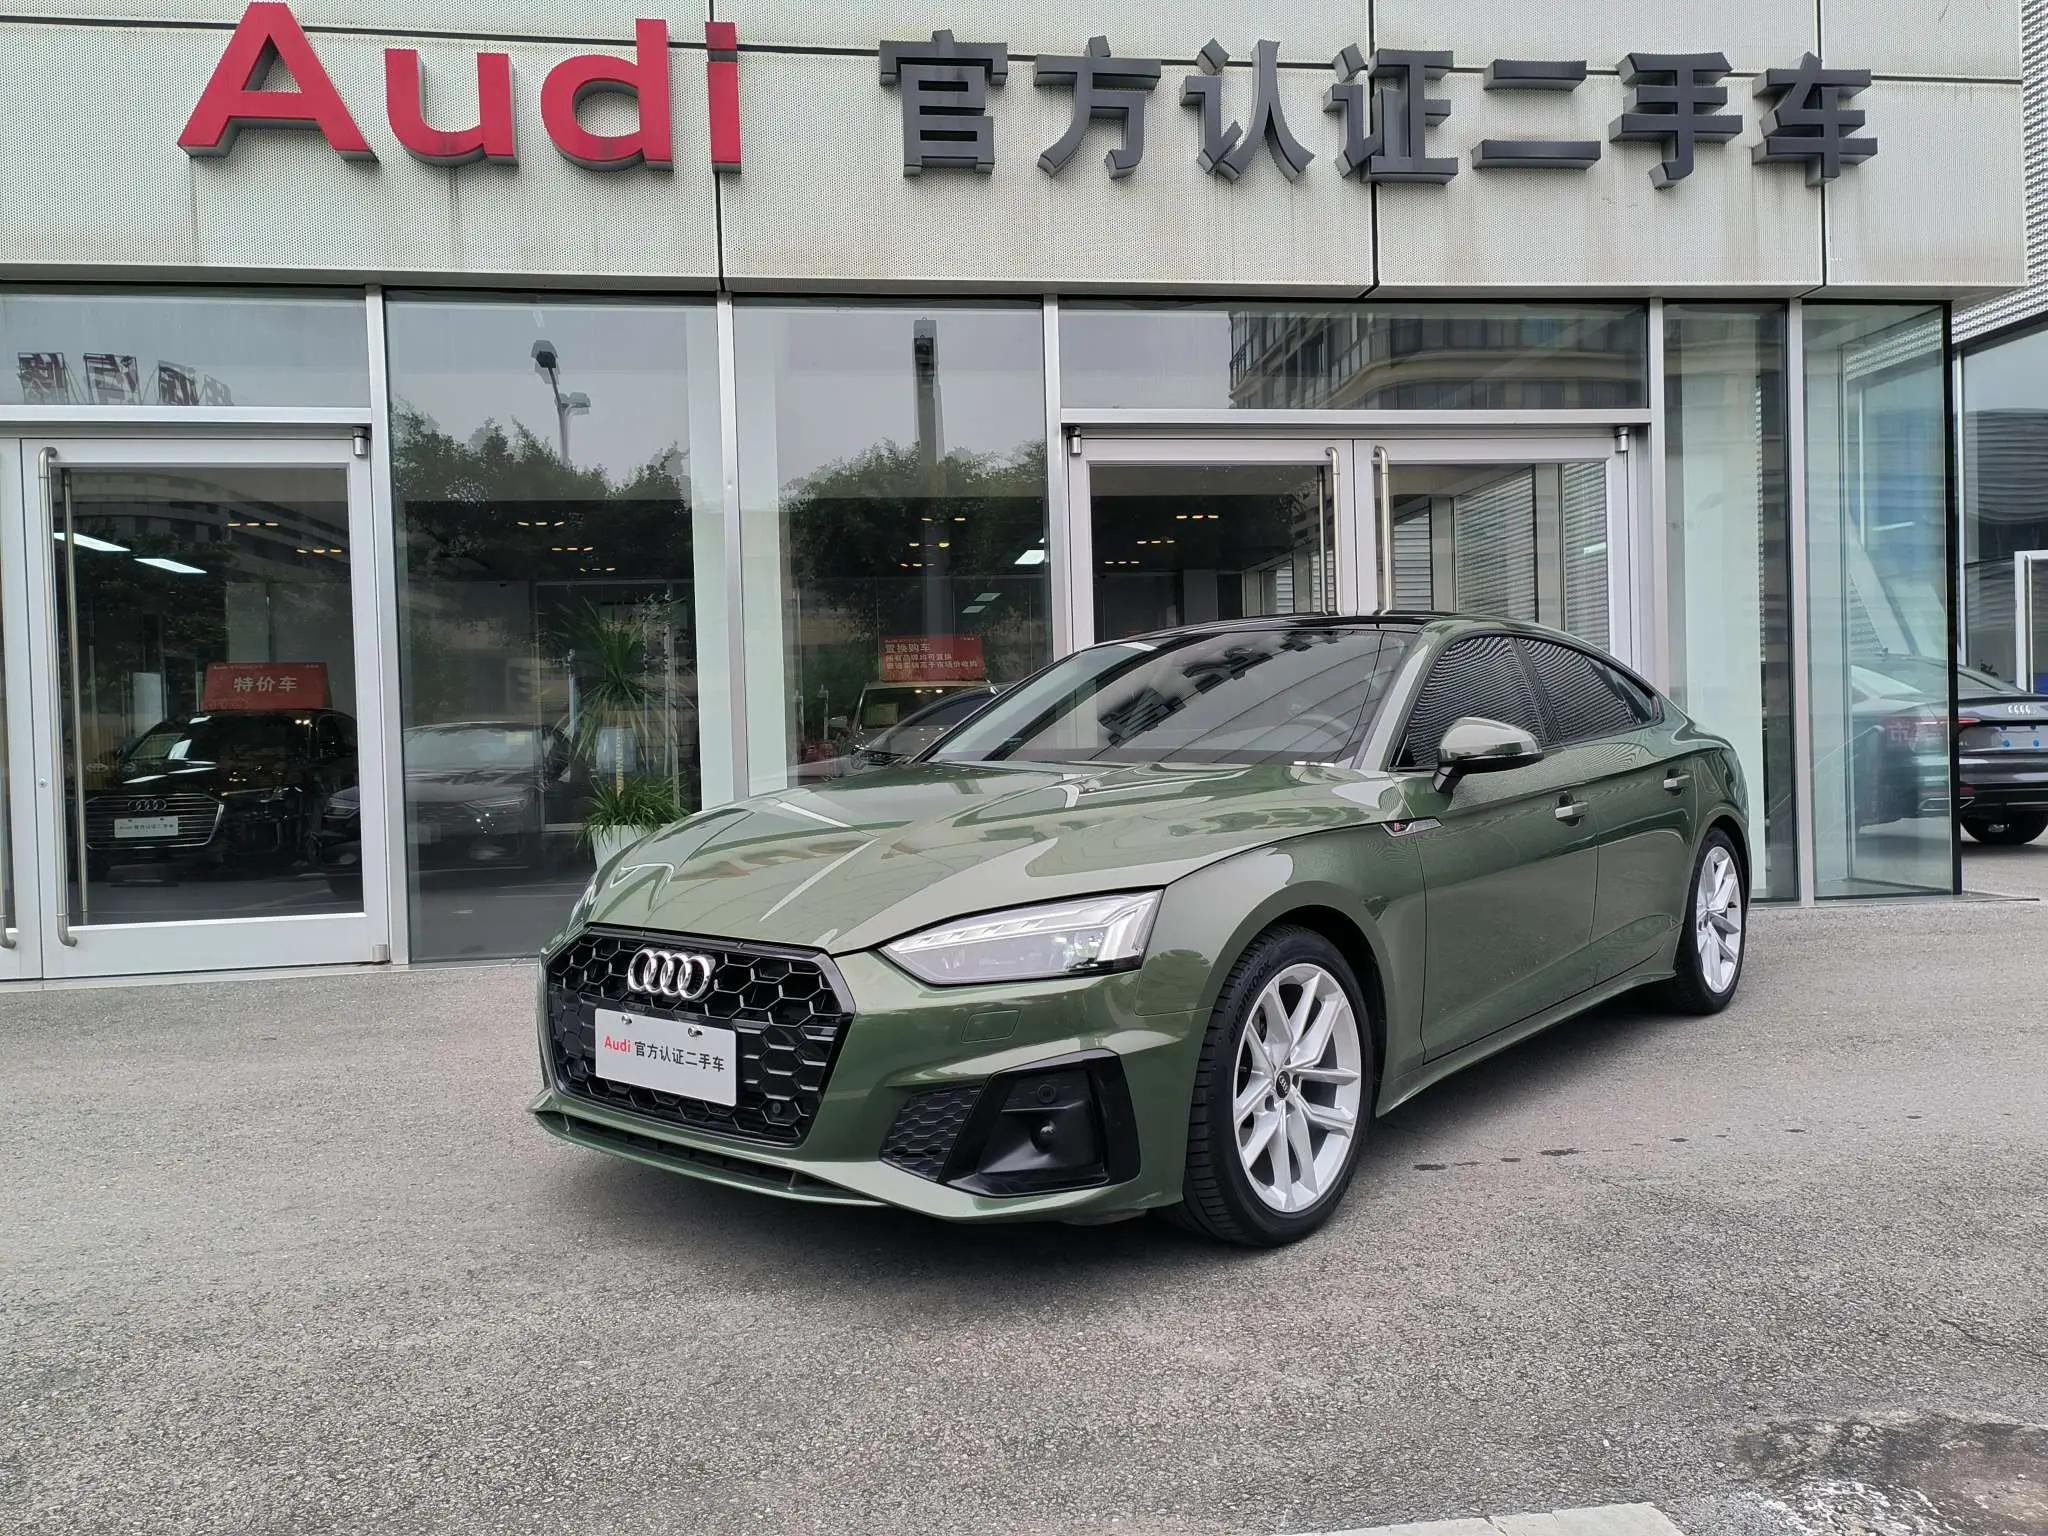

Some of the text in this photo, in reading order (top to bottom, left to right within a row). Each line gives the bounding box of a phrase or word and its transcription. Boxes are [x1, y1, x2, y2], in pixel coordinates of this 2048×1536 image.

[176, 2, 1878, 189] Audi 官方认证二手车
[233, 675, 297, 693] 特价车
[604, 1035, 725, 1073] Audi 官方认证二手车
